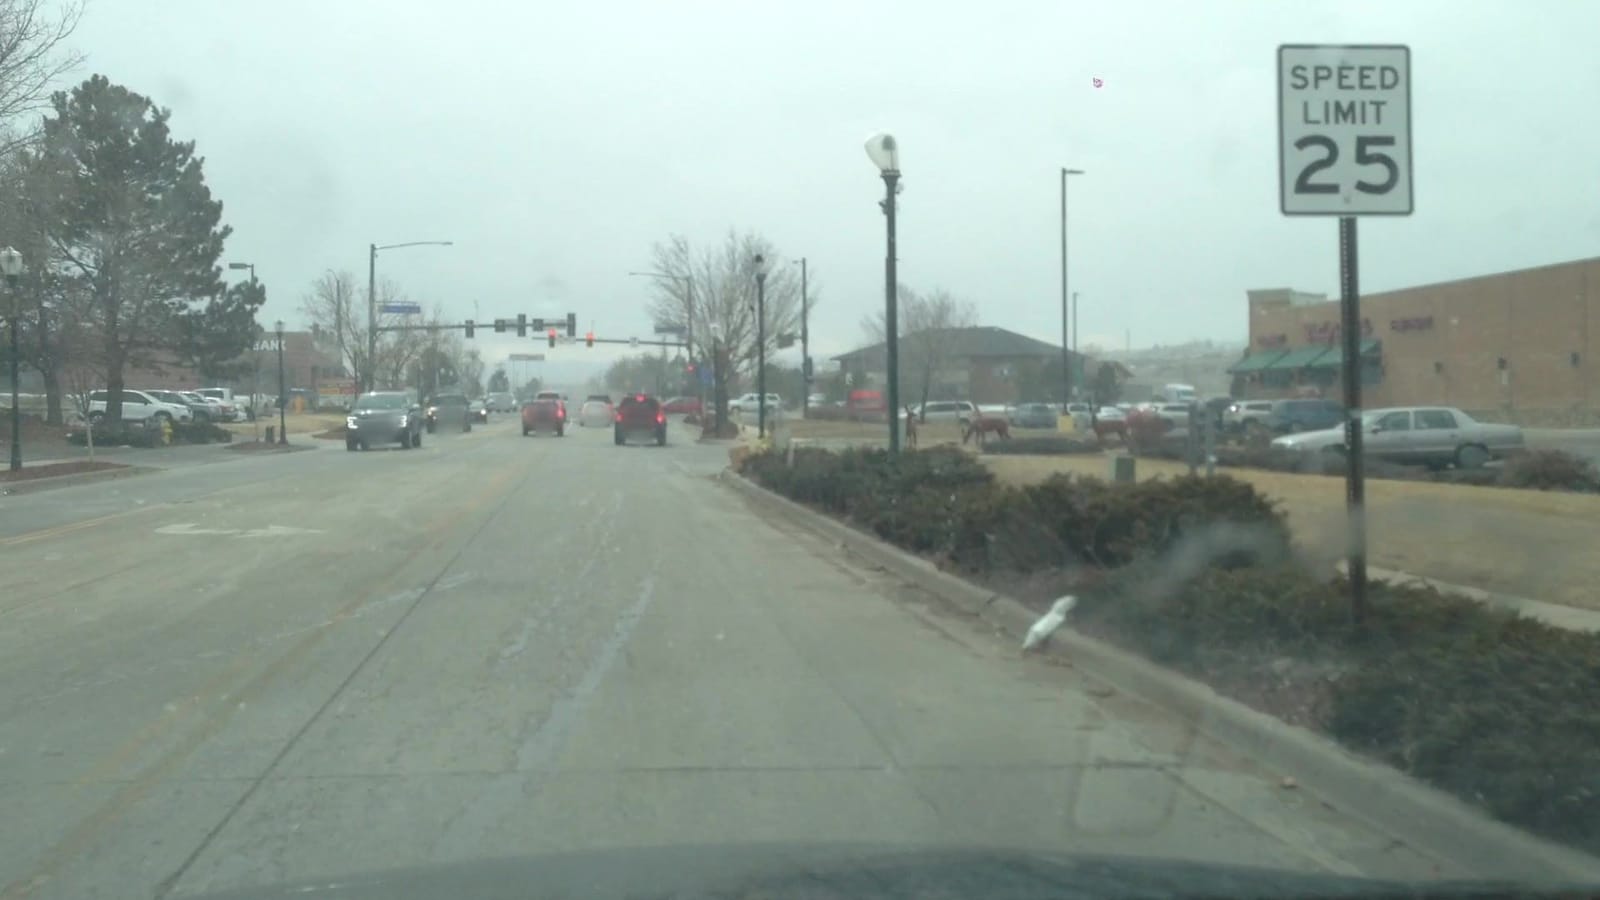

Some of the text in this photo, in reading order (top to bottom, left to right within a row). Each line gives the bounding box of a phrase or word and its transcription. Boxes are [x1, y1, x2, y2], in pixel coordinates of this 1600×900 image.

[1291, 65, 1399, 90] SPEED
[1303, 101, 1387, 125] LIMIT
[1294, 135, 1399, 195] 25
